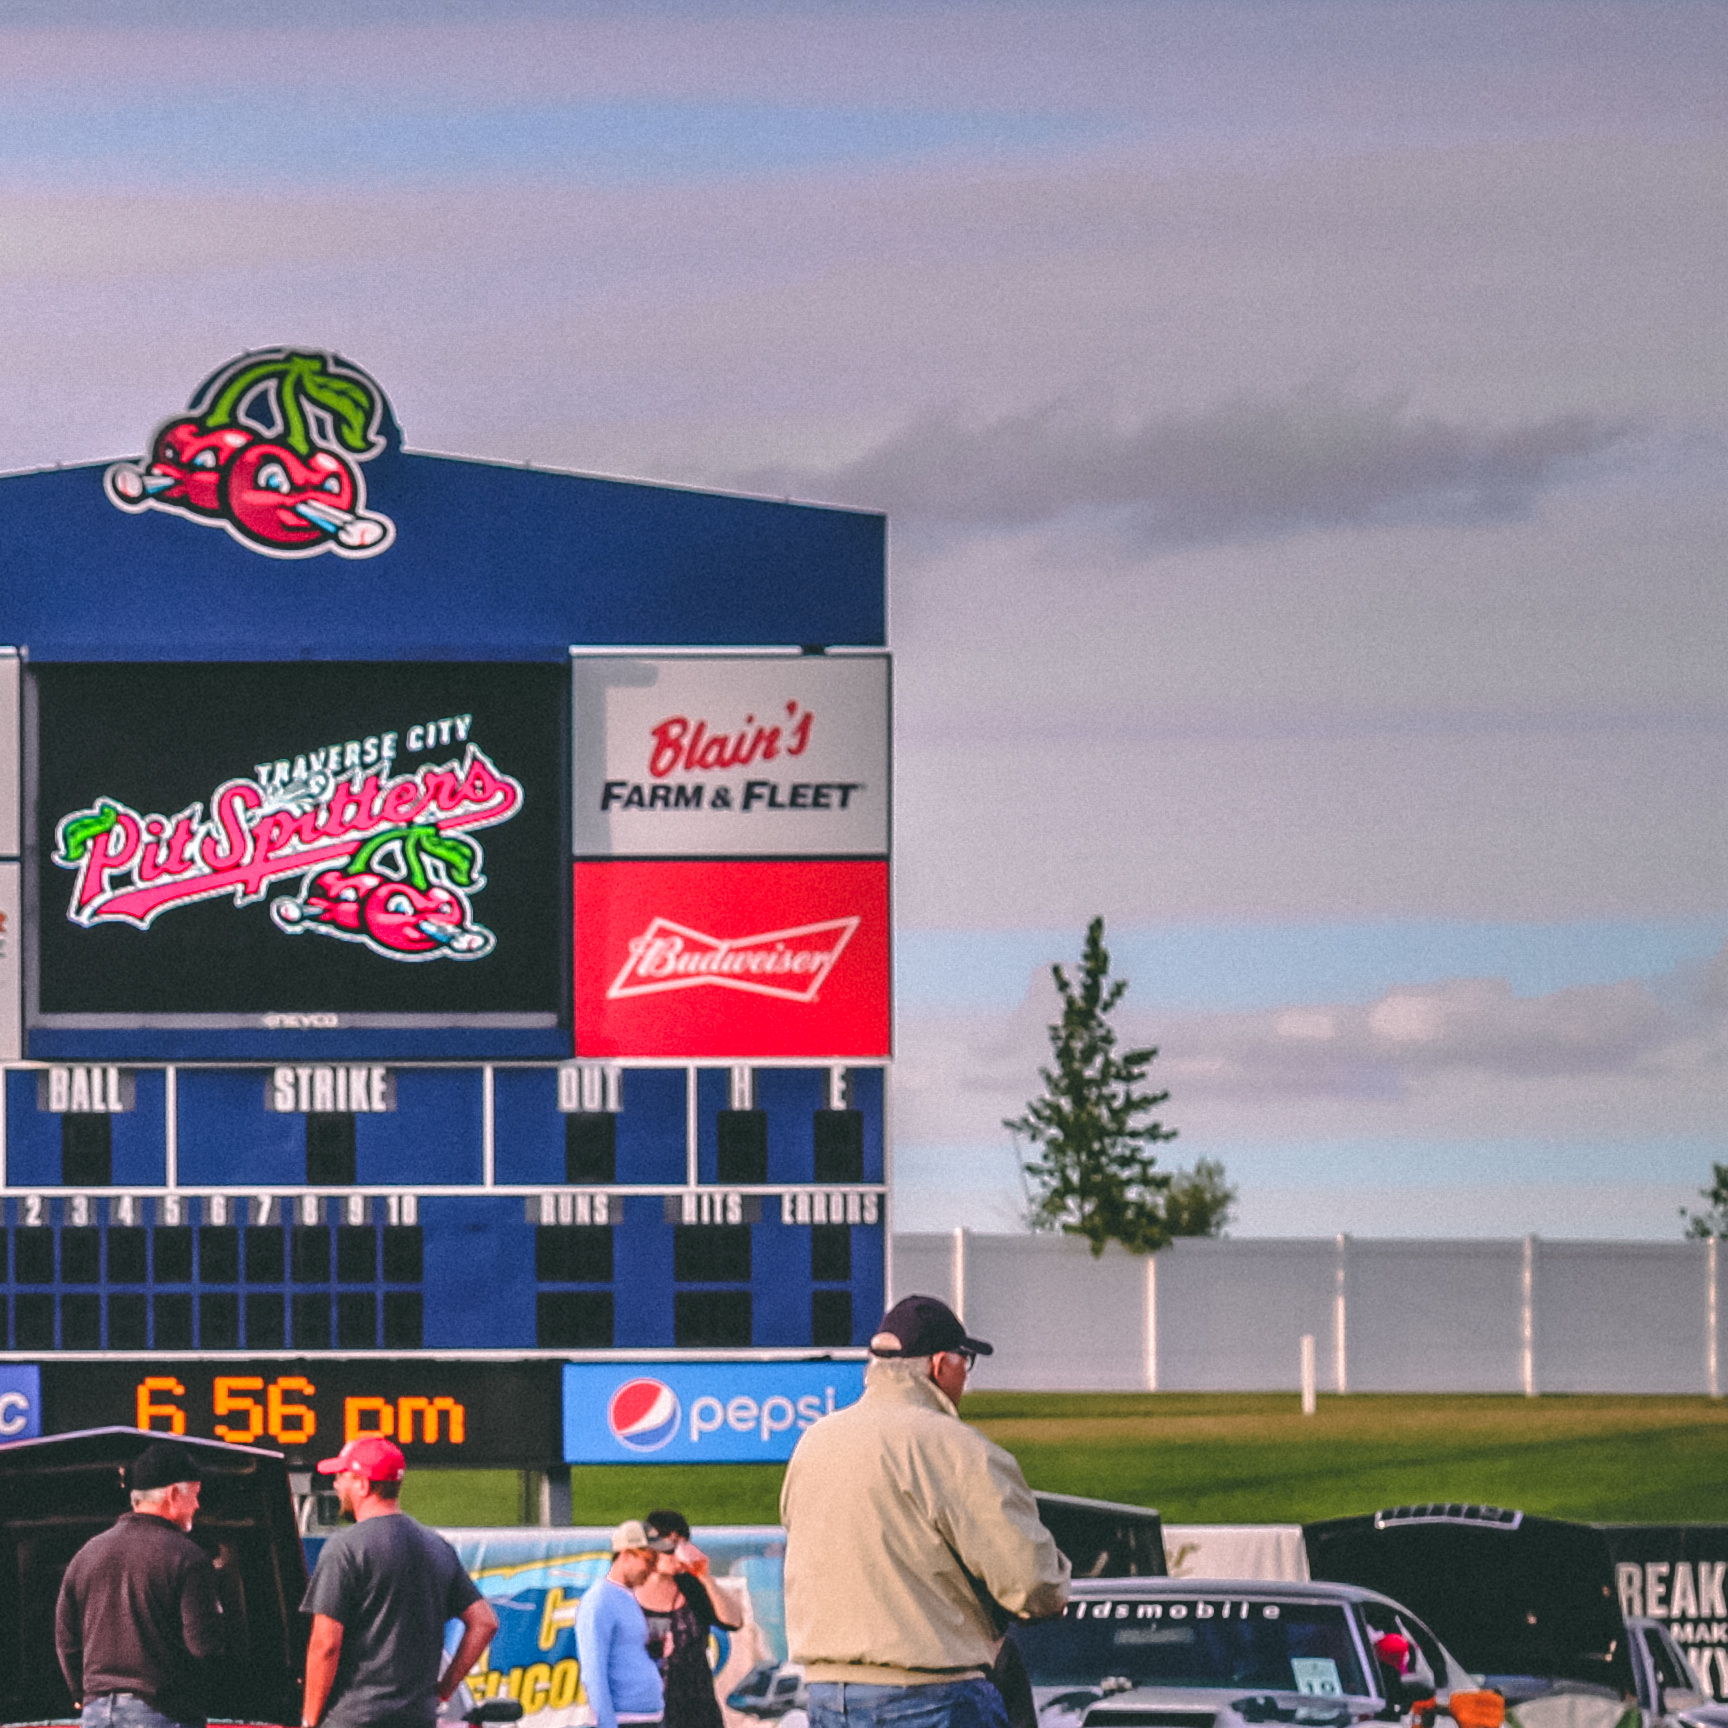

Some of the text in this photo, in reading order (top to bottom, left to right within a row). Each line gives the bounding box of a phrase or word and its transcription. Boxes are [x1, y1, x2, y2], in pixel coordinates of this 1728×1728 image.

[254, 713, 473, 788] TRAVERSE CITY
[648, 699, 814, 778] Blain's
[600, 780, 860, 812] FARM & FLEET
[74, 756, 519, 908] Pit Spitters
[628, 935, 834, 979] Budweiser
[47, 1066, 125, 1113] BALL
[273, 1066, 388, 1113] STRIKE
[557, 1066, 623, 1113] OUT
[730, 1066, 754, 1112] H
[829, 1066, 849, 1112] E
[24, 1194, 43, 1227] 2
[71, 1194, 89, 1227] 3
[116, 1194, 135, 1227] 4
[163, 1194, 181, 1227] 5
[209, 1194, 227, 1227] 6
[255, 1194, 274, 1227] 7
[301, 1194, 320, 1227] 8
[347, 1194, 365, 1227] 9
[387, 1194, 419, 1227] 10
[540, 1194, 610, 1226] RUNS
[681, 1194, 743, 1226] HITS
[780, 1194, 879, 1226] ERRORS
[344, 1396, 466, 1445] pm
[690, 1386, 836, 1442] pepsi
[1061, 1600, 1282, 1621] ldsmobile
